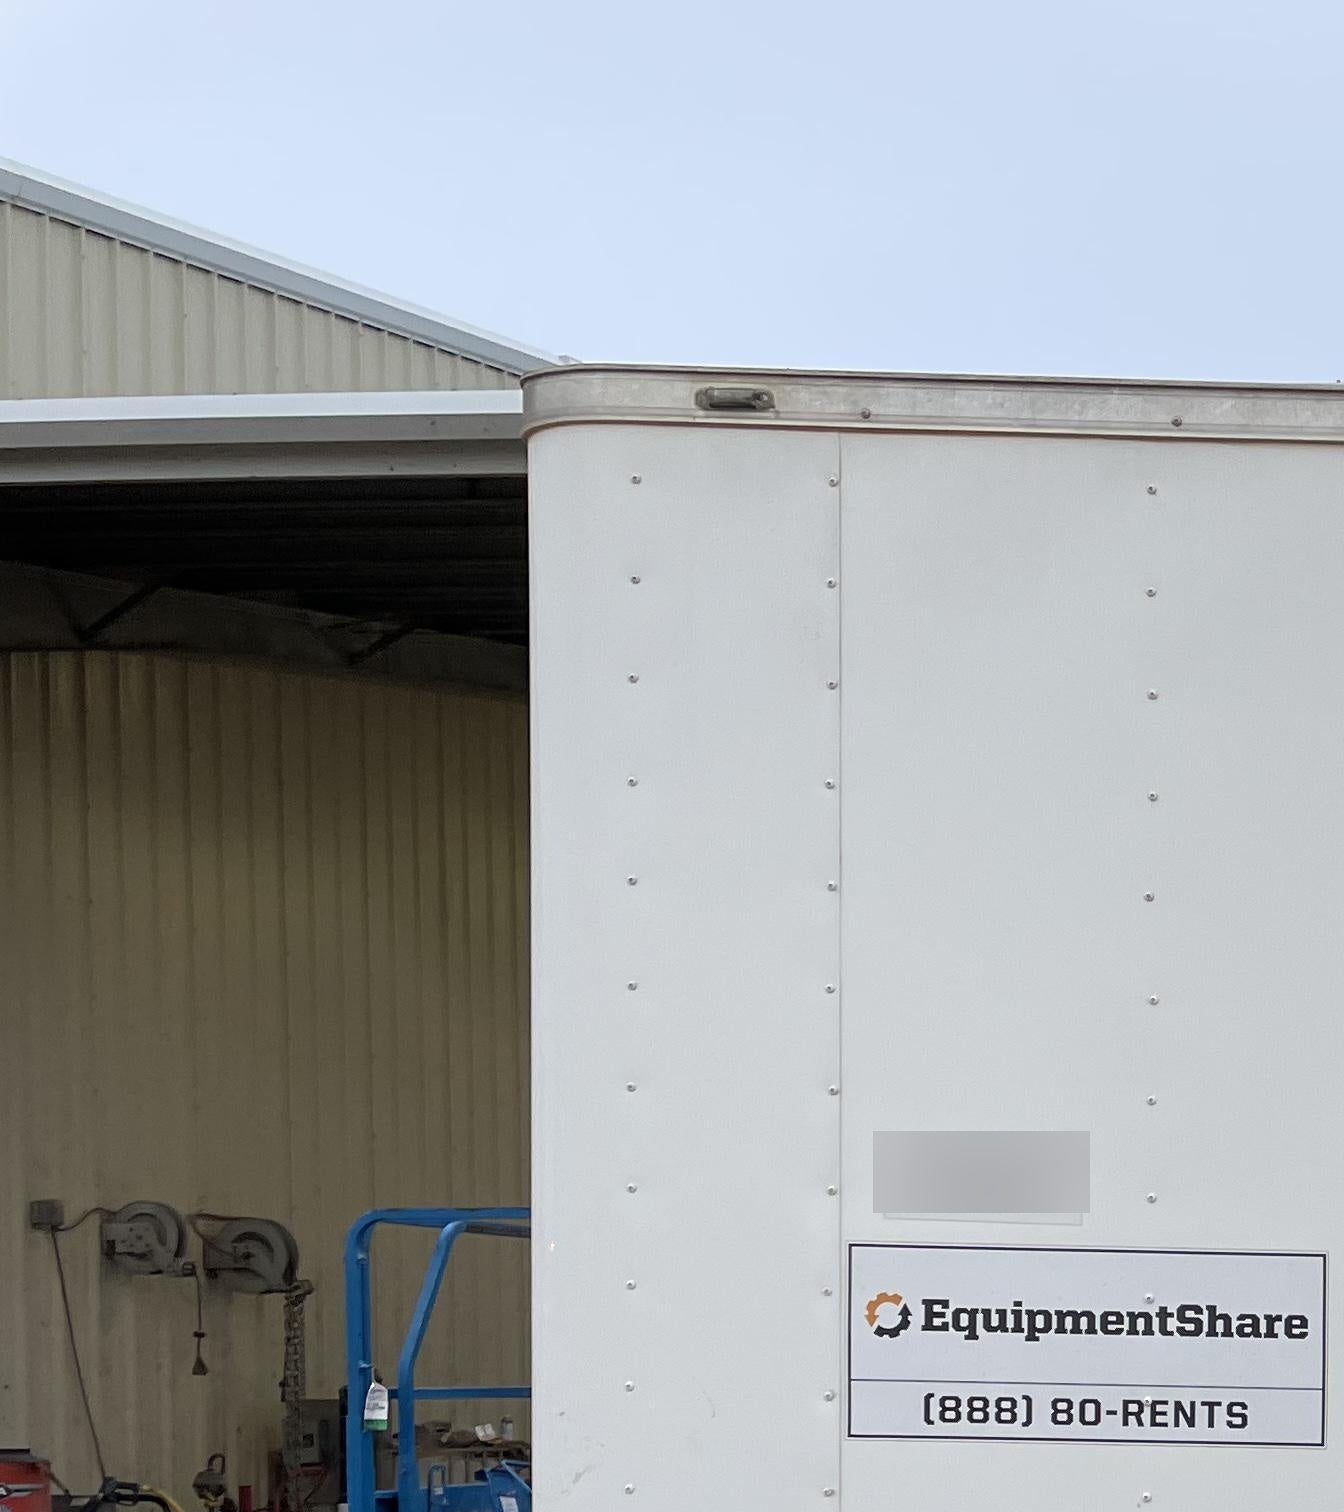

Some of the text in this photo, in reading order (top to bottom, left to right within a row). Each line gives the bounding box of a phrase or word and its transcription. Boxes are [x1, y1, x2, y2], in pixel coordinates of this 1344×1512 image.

[921, 1298, 1310, 1342] EquipmentShare
[923, 1392, 1250, 1430] (888) 80-RENTS
